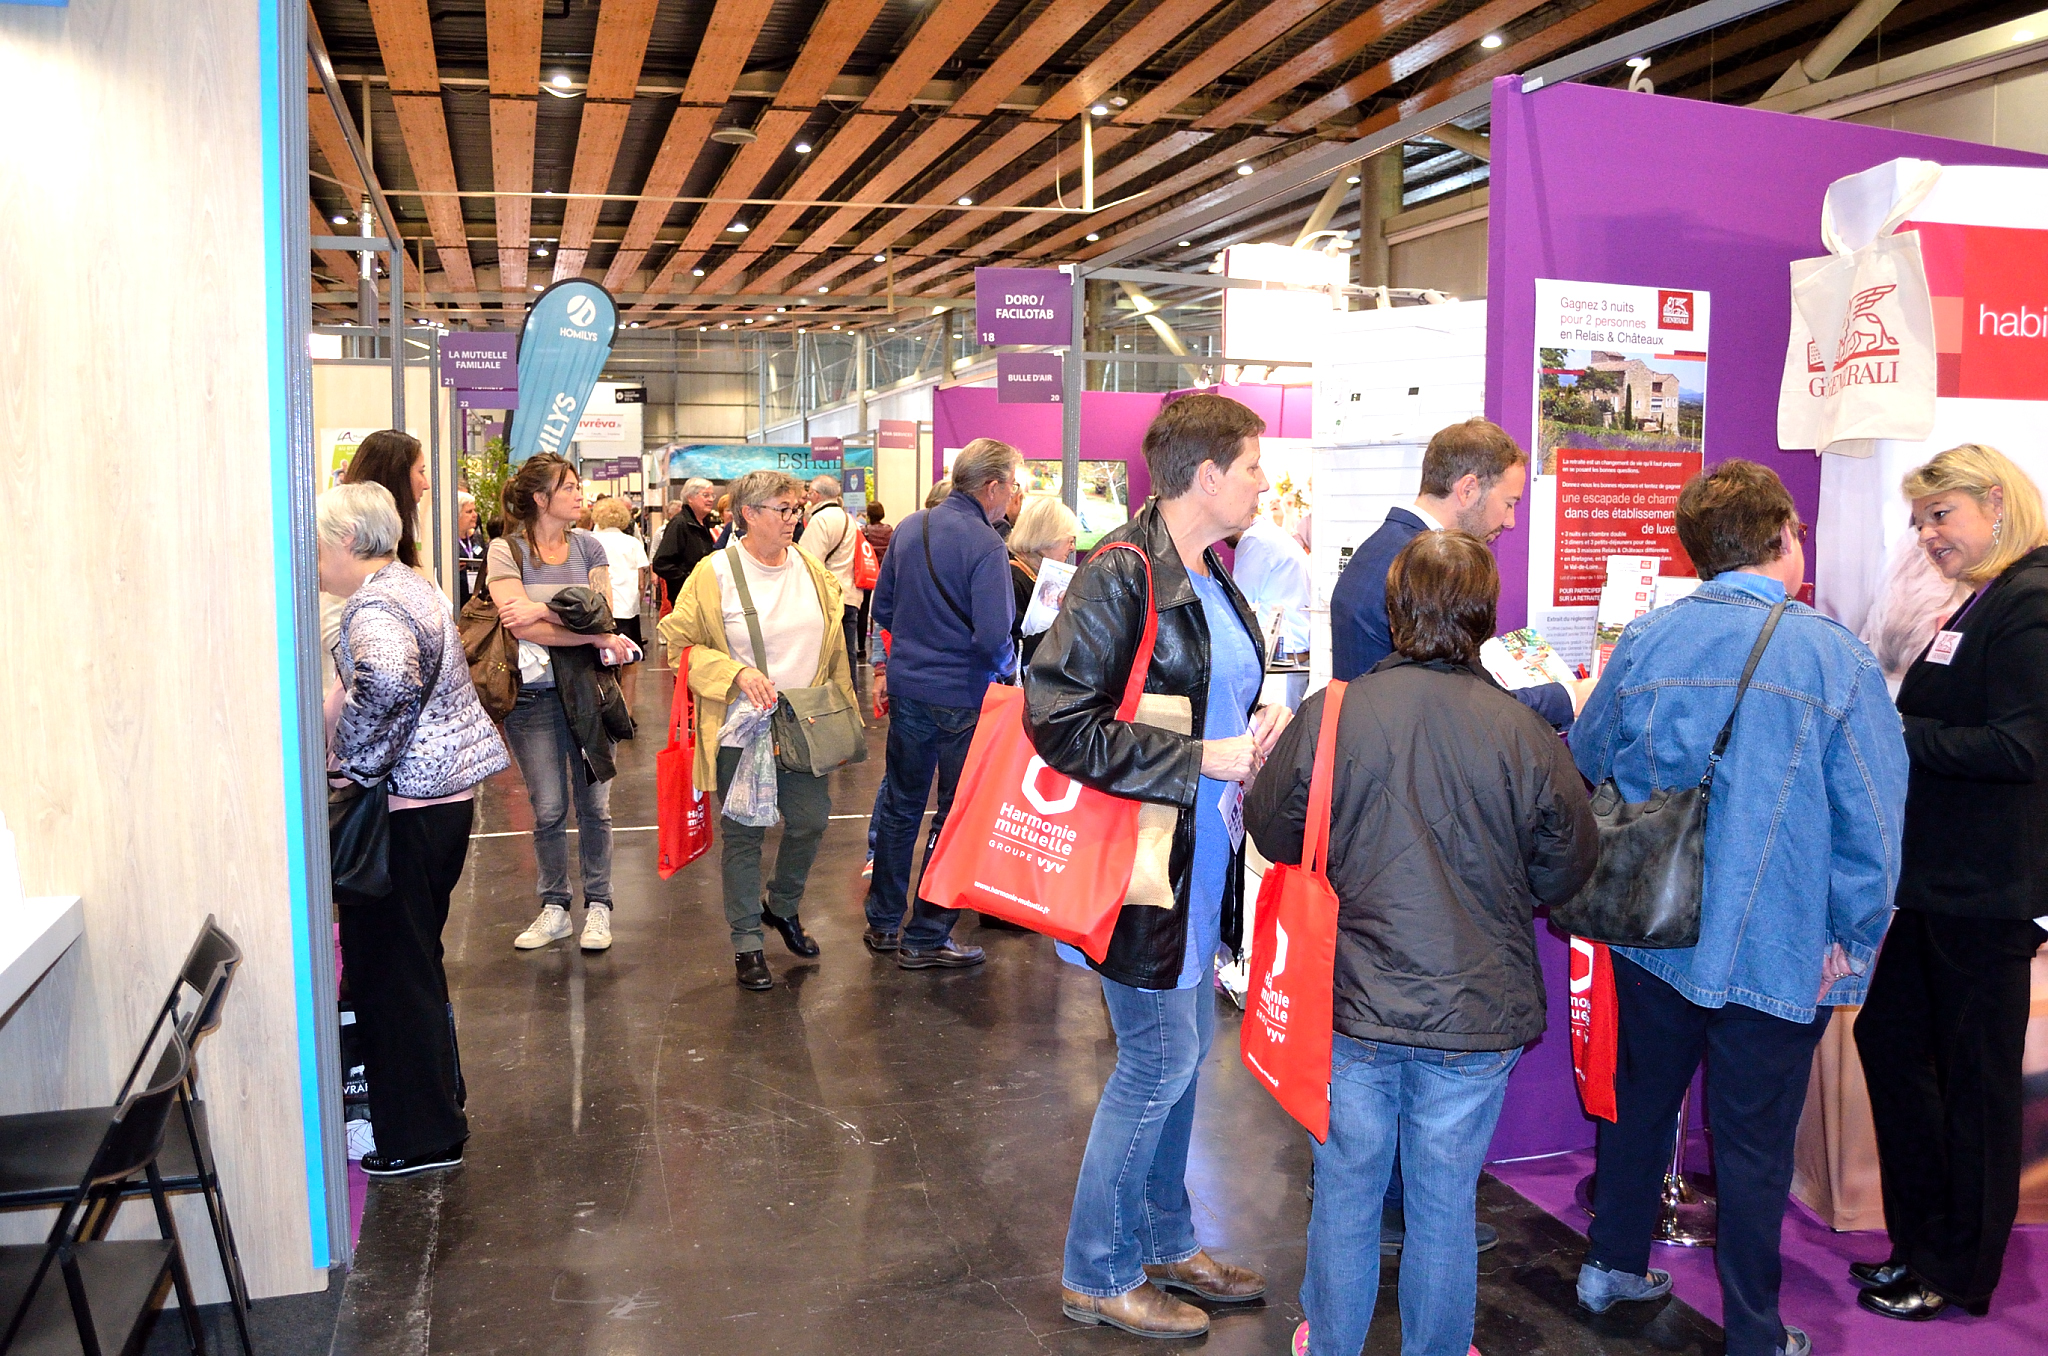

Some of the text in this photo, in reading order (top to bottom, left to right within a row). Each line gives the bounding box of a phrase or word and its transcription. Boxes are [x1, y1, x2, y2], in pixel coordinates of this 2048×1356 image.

[1005, 295, 1044, 306] DORO /
[1560, 297, 1634, 313] Gagnez 3 nuits
[996, 308, 1054, 319] FACILOTAB
[1560, 314, 1646, 329] pour 2 personnes
[560, 327, 598, 342] HOMILYS
[982, 332, 995, 342] 18
[1560, 329, 1664, 345] en Relais & Châteaux
[462, 351, 508, 360] MUTUELLE
[456, 361, 501, 369] FAMILIALE
[1562, 494, 1580, 503] une
[1582, 493, 1630, 506] escapade
[1632, 493, 1646, 504] de
[1564, 507, 1589, 519] dans
[1591, 508, 1610, 519] des
[1642, 523, 1676, 534] de luxe
[1000, 802, 1076, 842] Harmonie
[994, 818, 1072, 856] mutuelle
[988, 840, 1066, 874] GROUPE vyv
[1266, 1026, 1285, 1043] vyv
